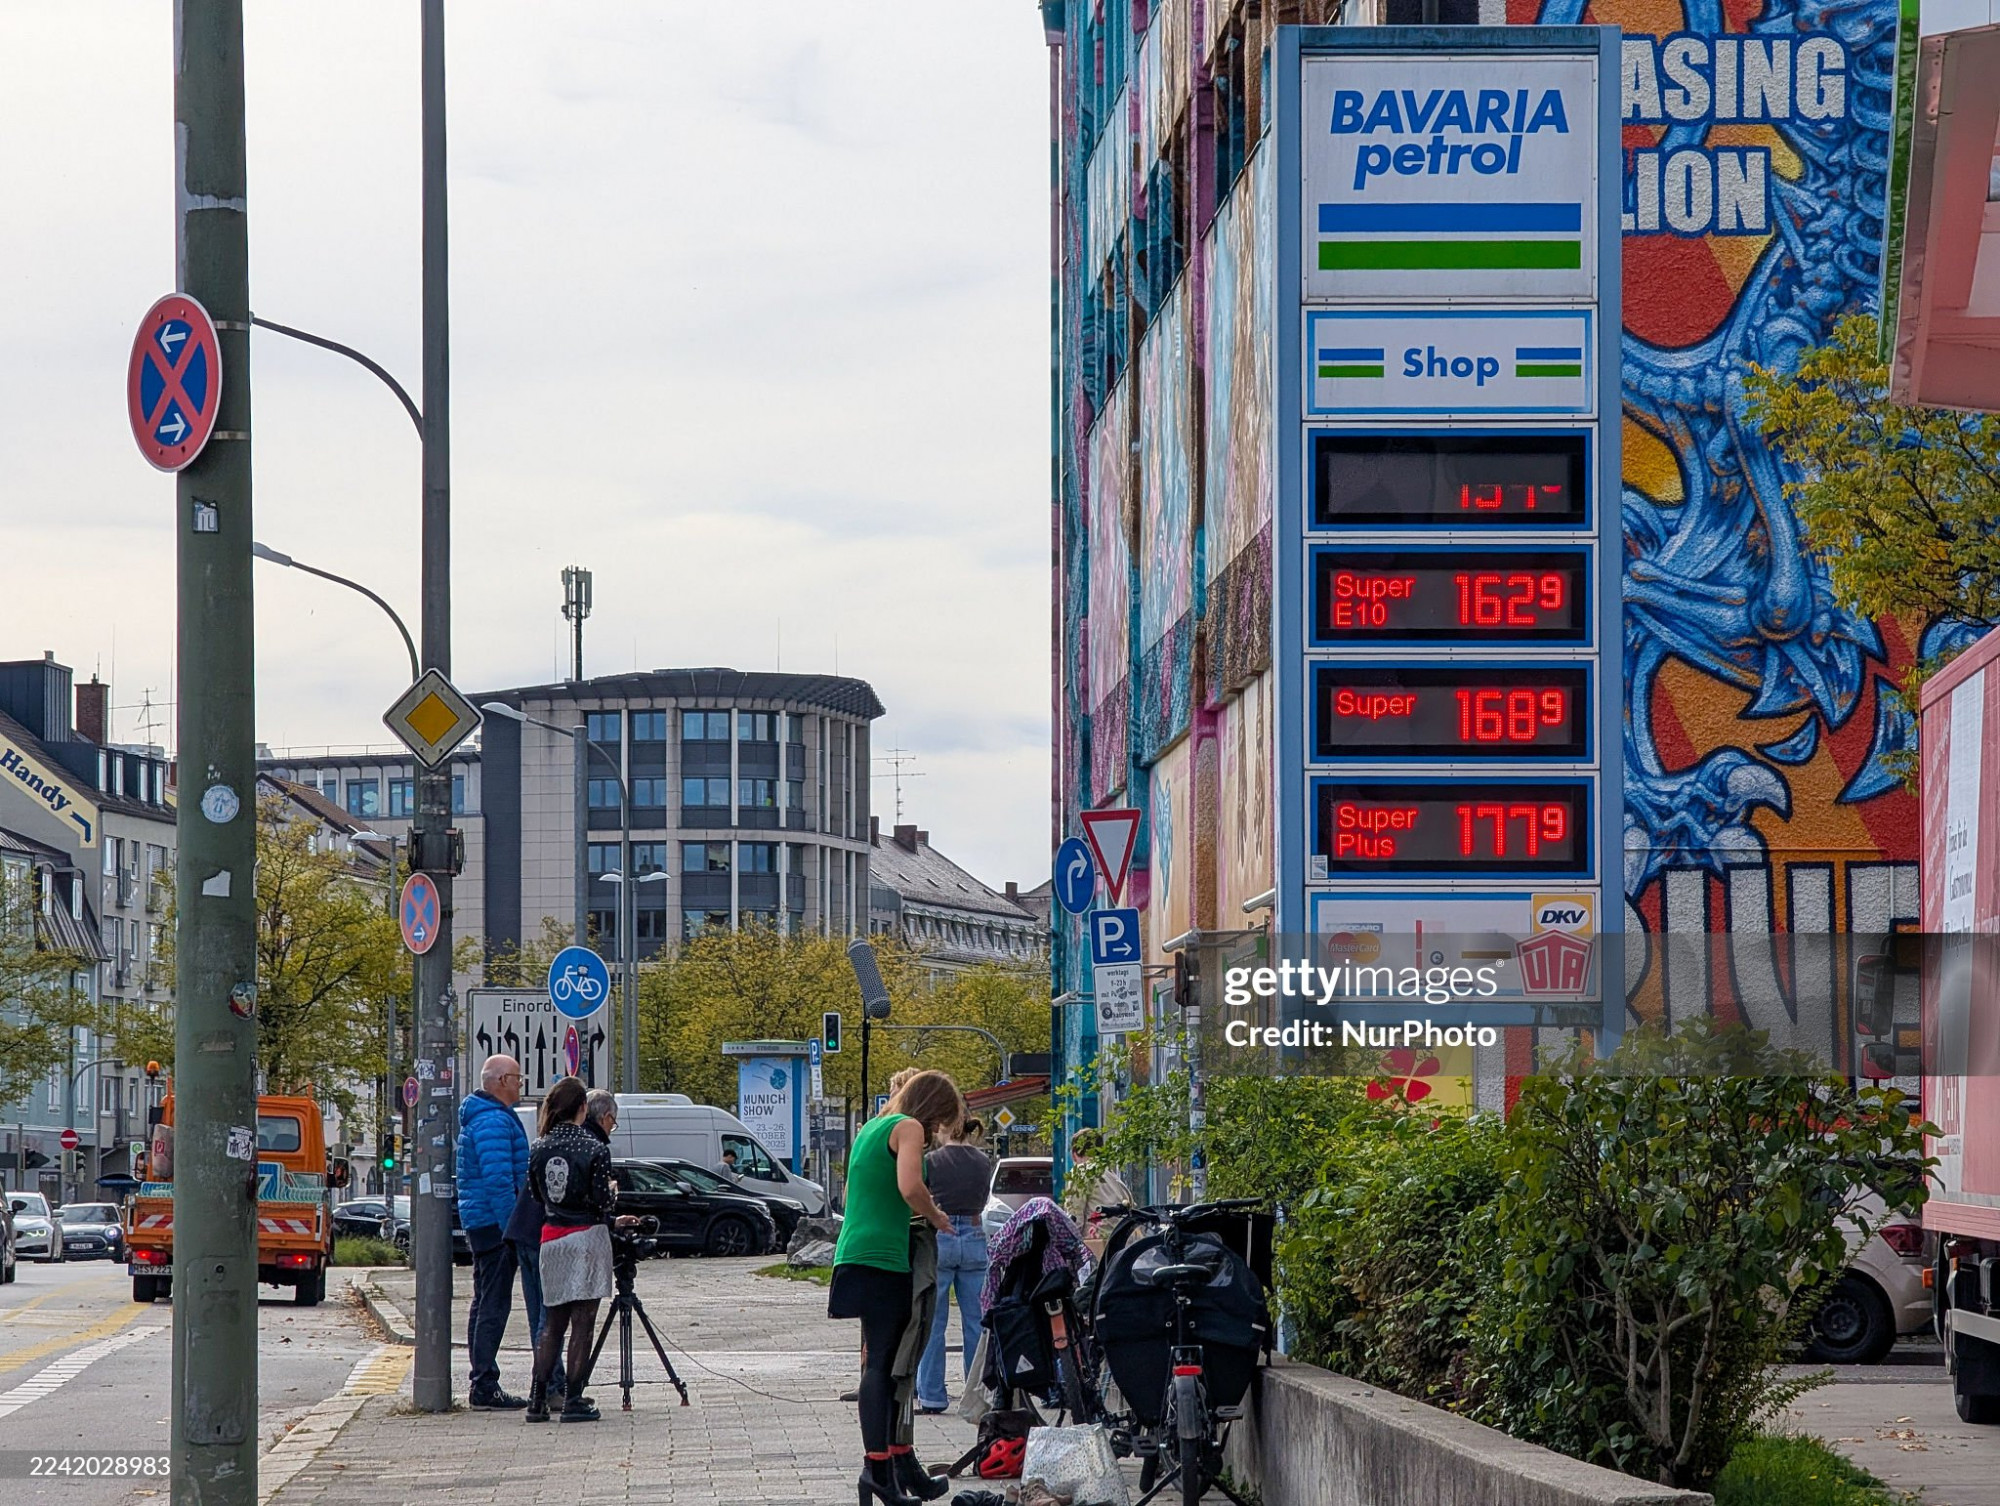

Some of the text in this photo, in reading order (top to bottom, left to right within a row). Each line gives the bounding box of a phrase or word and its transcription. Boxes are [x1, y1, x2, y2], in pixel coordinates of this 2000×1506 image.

[1330, 88, 1569, 135] BAVARIA
[1353, 134, 1523, 190] petrol
[1402, 346, 1500, 386] Shop
[1336, 574, 1563, 625] Super 1629
[1336, 603, 1386, 626] E10
[1337, 690, 1563, 740] Super 1689
[0, 747, 73, 813] Handy
[1337, 834, 1395, 857] Plus
[1338, 806, 1565, 856] Super 1779
[1098, 916, 1125, 957] P
[1540, 909, 1586, 924] DKV
[1520, 931, 1590, 990] UTA
[743, 1093, 786, 1104] MUNICH
[743, 1106, 774, 1116] SHOW
[755, 1132, 786, 1140] TOBER
[765, 1140, 786, 1148] 2025
